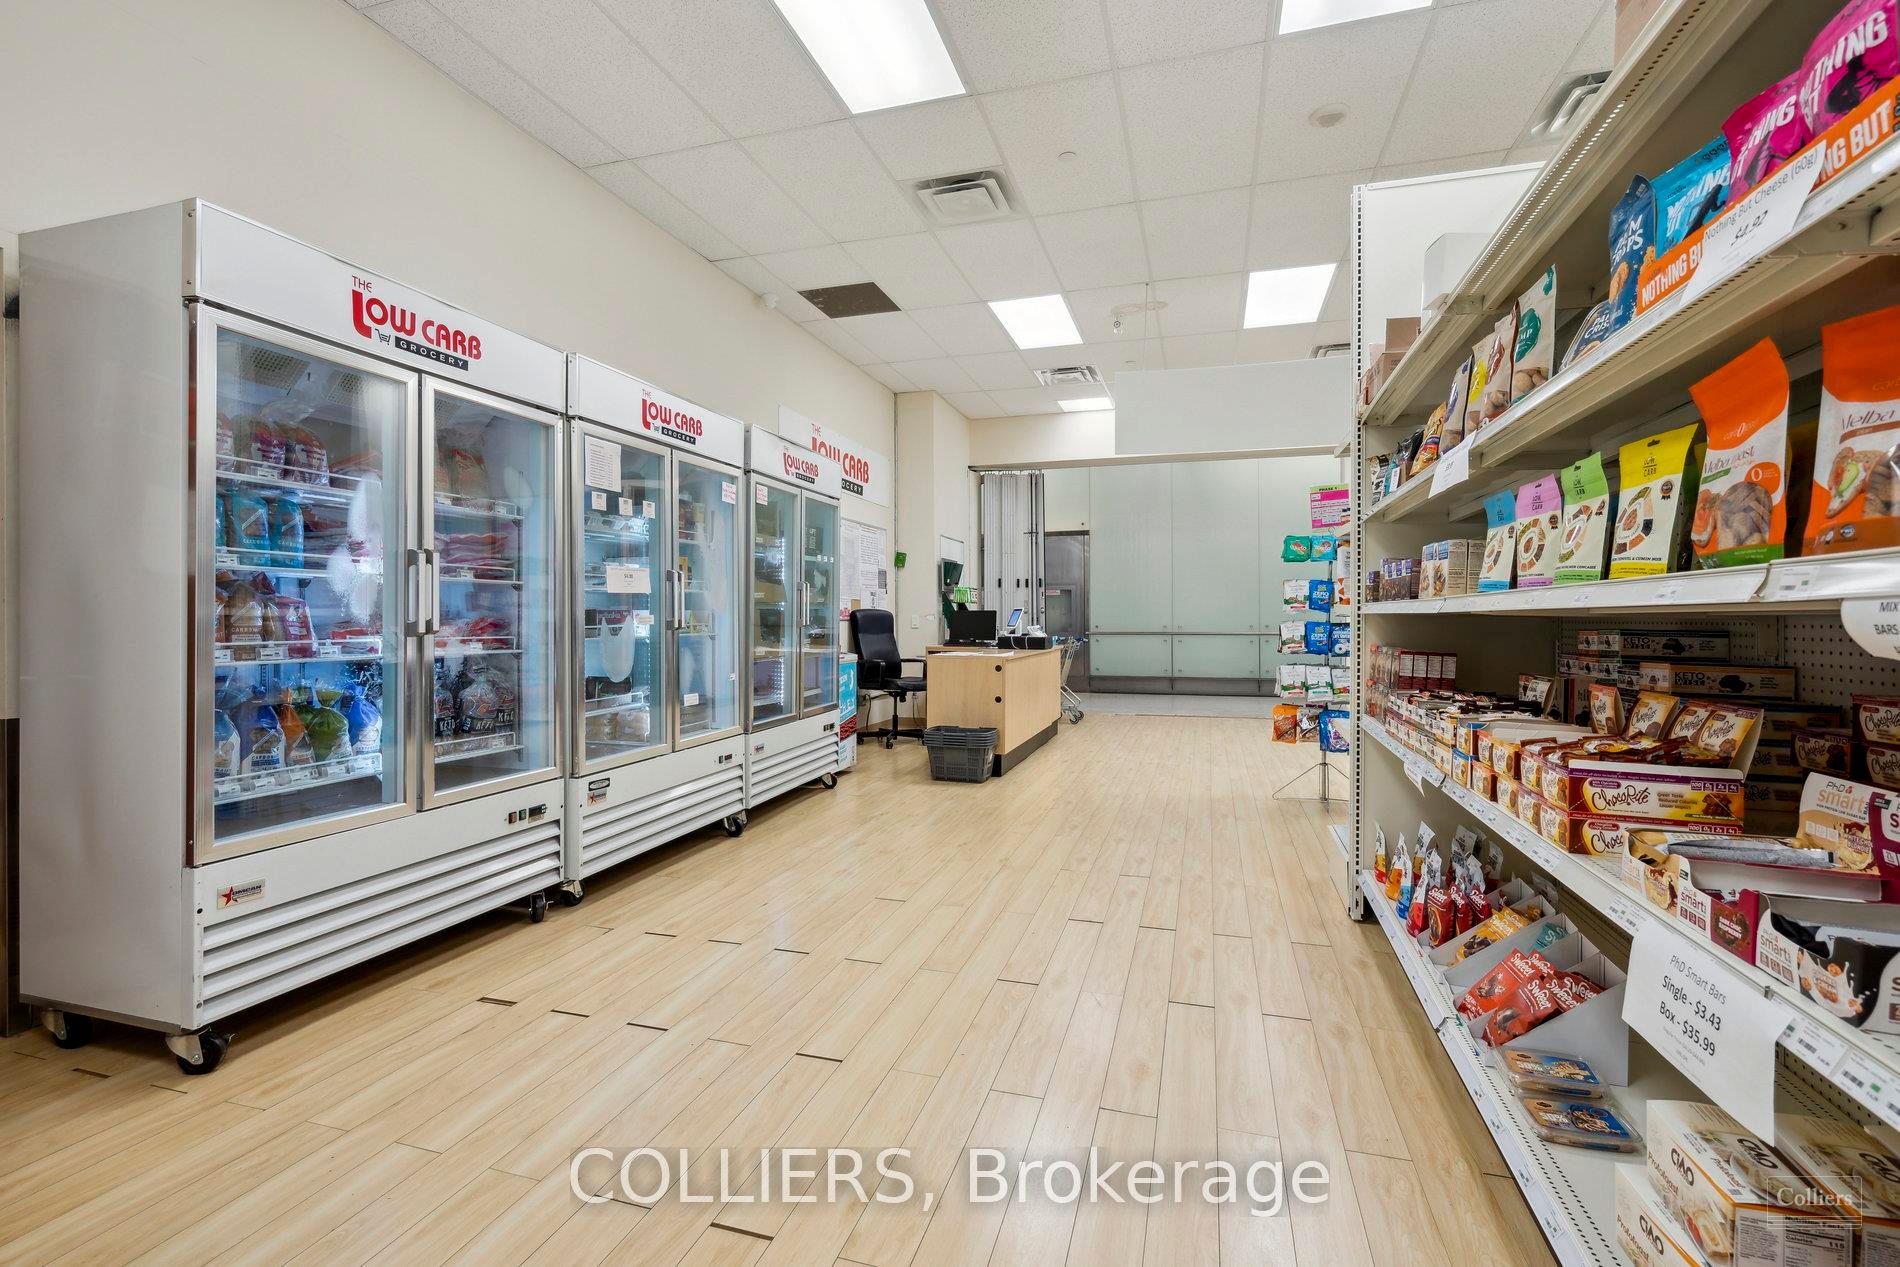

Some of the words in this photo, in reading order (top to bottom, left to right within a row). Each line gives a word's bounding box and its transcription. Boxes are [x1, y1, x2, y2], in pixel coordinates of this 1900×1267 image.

[1850, 99, 1891, 157] BUT
[1705, 211, 1736, 241] Nothing
[1738, 199, 1753, 218] But
[1754, 172, 1789, 205] Cheese
[352, 275, 373, 293] THE
[1642, 253, 1688, 307] NOTHING
[352, 289, 416, 339] LOW
[422, 319, 482, 360] CARB
[400, 340, 464, 367] GROCERY
[642, 398, 672, 430] LOW
[674, 412, 703, 437] CARB
[663, 428, 694, 442] GROCERY
[783, 452, 801, 476] LOW
[801, 460, 819, 478] CARB
[842, 452, 869, 484] CARB
[1873, 624, 1900, 635] BARS
[1674, 672, 1705, 680] KETO
[1592, 784, 1651, 811] ChocoRite
[1826, 781, 1846, 793] PhD
[1818, 789, 1865, 814] smart
[1681, 891, 1705, 913] smart
[1760, 935, 1789, 962] smart
[1511, 953, 1535, 977] Sweet
[1670, 955, 1686, 972] PhD
[1685, 966, 1708, 990] Smart
[1708, 983, 1727, 1005] Bars
[1528, 980, 1552, 1010] Sweet
[1662, 975, 1688, 1004] Single
[1694, 999, 1722, 1031] $3.43
[1659, 1001, 1675, 1024] Box
[1682, 1020, 1716, 1057] $35.99
